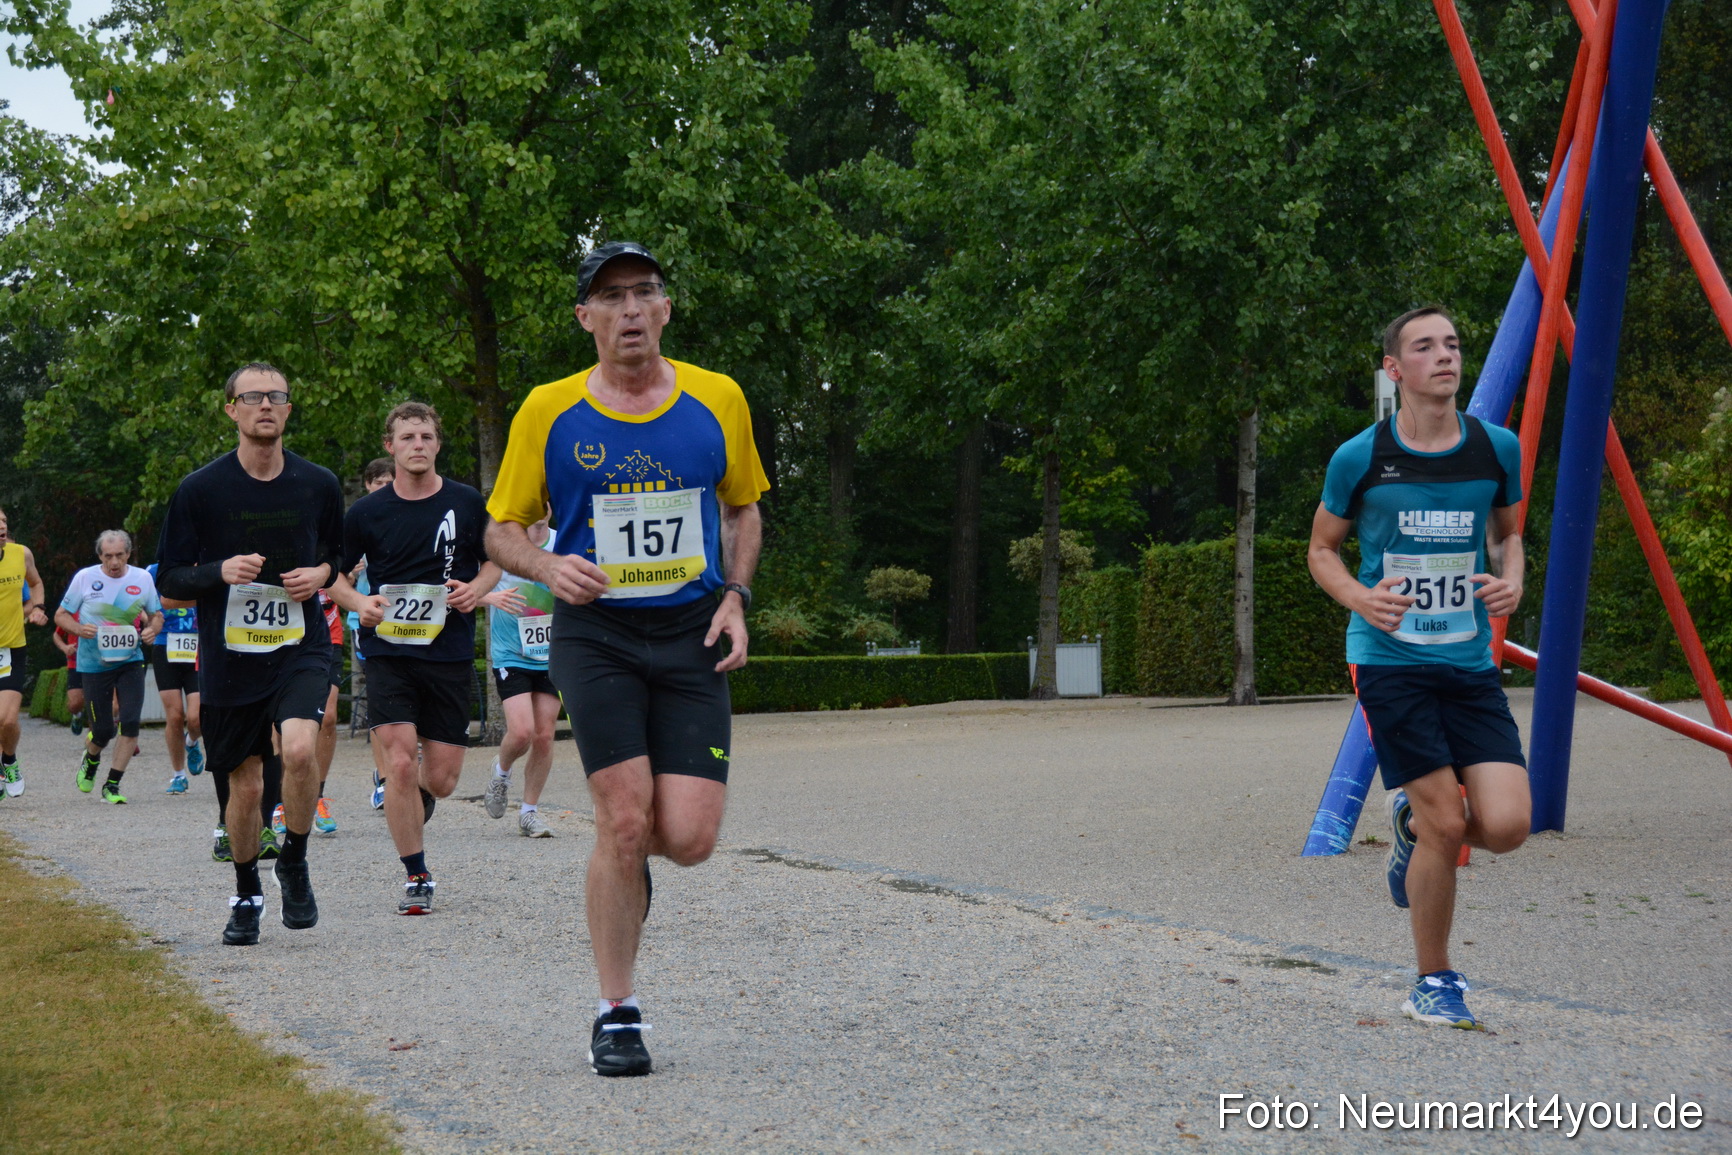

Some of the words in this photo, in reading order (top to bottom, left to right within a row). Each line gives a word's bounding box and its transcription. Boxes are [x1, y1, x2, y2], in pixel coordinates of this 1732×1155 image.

[644, 493, 692, 509] BOCK
[1398, 510, 1475, 527] HUBER
[619, 517, 683, 557] 157
[1415, 527, 1470, 535] TECHNOLOGY
[1391, 563, 1422, 571] NeuerMarkt
[1427, 556, 1468, 568] BOCK
[619, 566, 687, 584] Johannes
[243, 600, 289, 626] 349
[394, 598, 433, 621] 222
[393, 626, 427, 636] Thomas
[1415, 618, 1448, 632] Lukas
[102, 634, 134, 648] 3049
[176, 638, 197, 651] 165
[246, 632, 285, 643] Torsten
